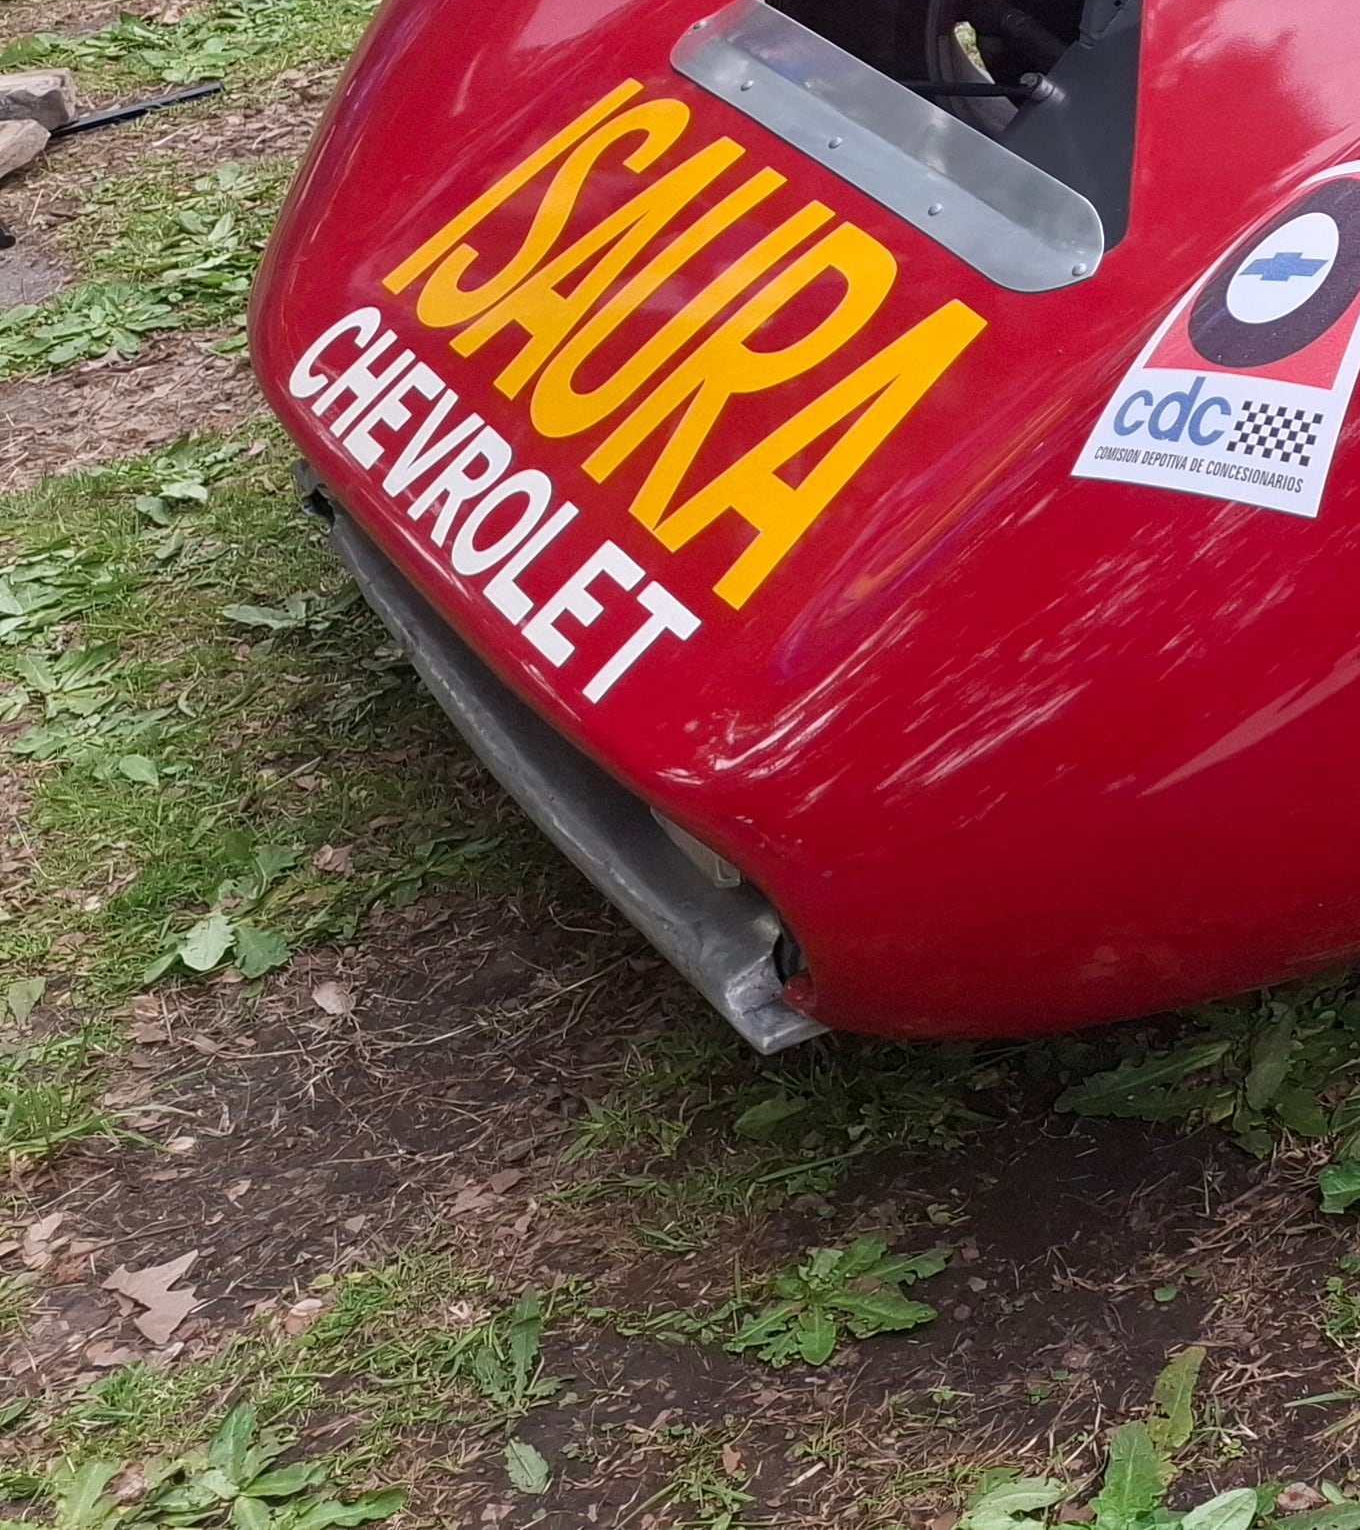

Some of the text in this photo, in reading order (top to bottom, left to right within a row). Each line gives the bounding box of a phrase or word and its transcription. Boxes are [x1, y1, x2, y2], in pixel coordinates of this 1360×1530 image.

[381, 77, 988, 611] ISAURA
[1113, 376, 1232, 447] cdc
[288, 306, 702, 705] CHEVROLET
[1094, 445, 1305, 494] COMISION DEPOTIVA DE CONCESIONARIOS
